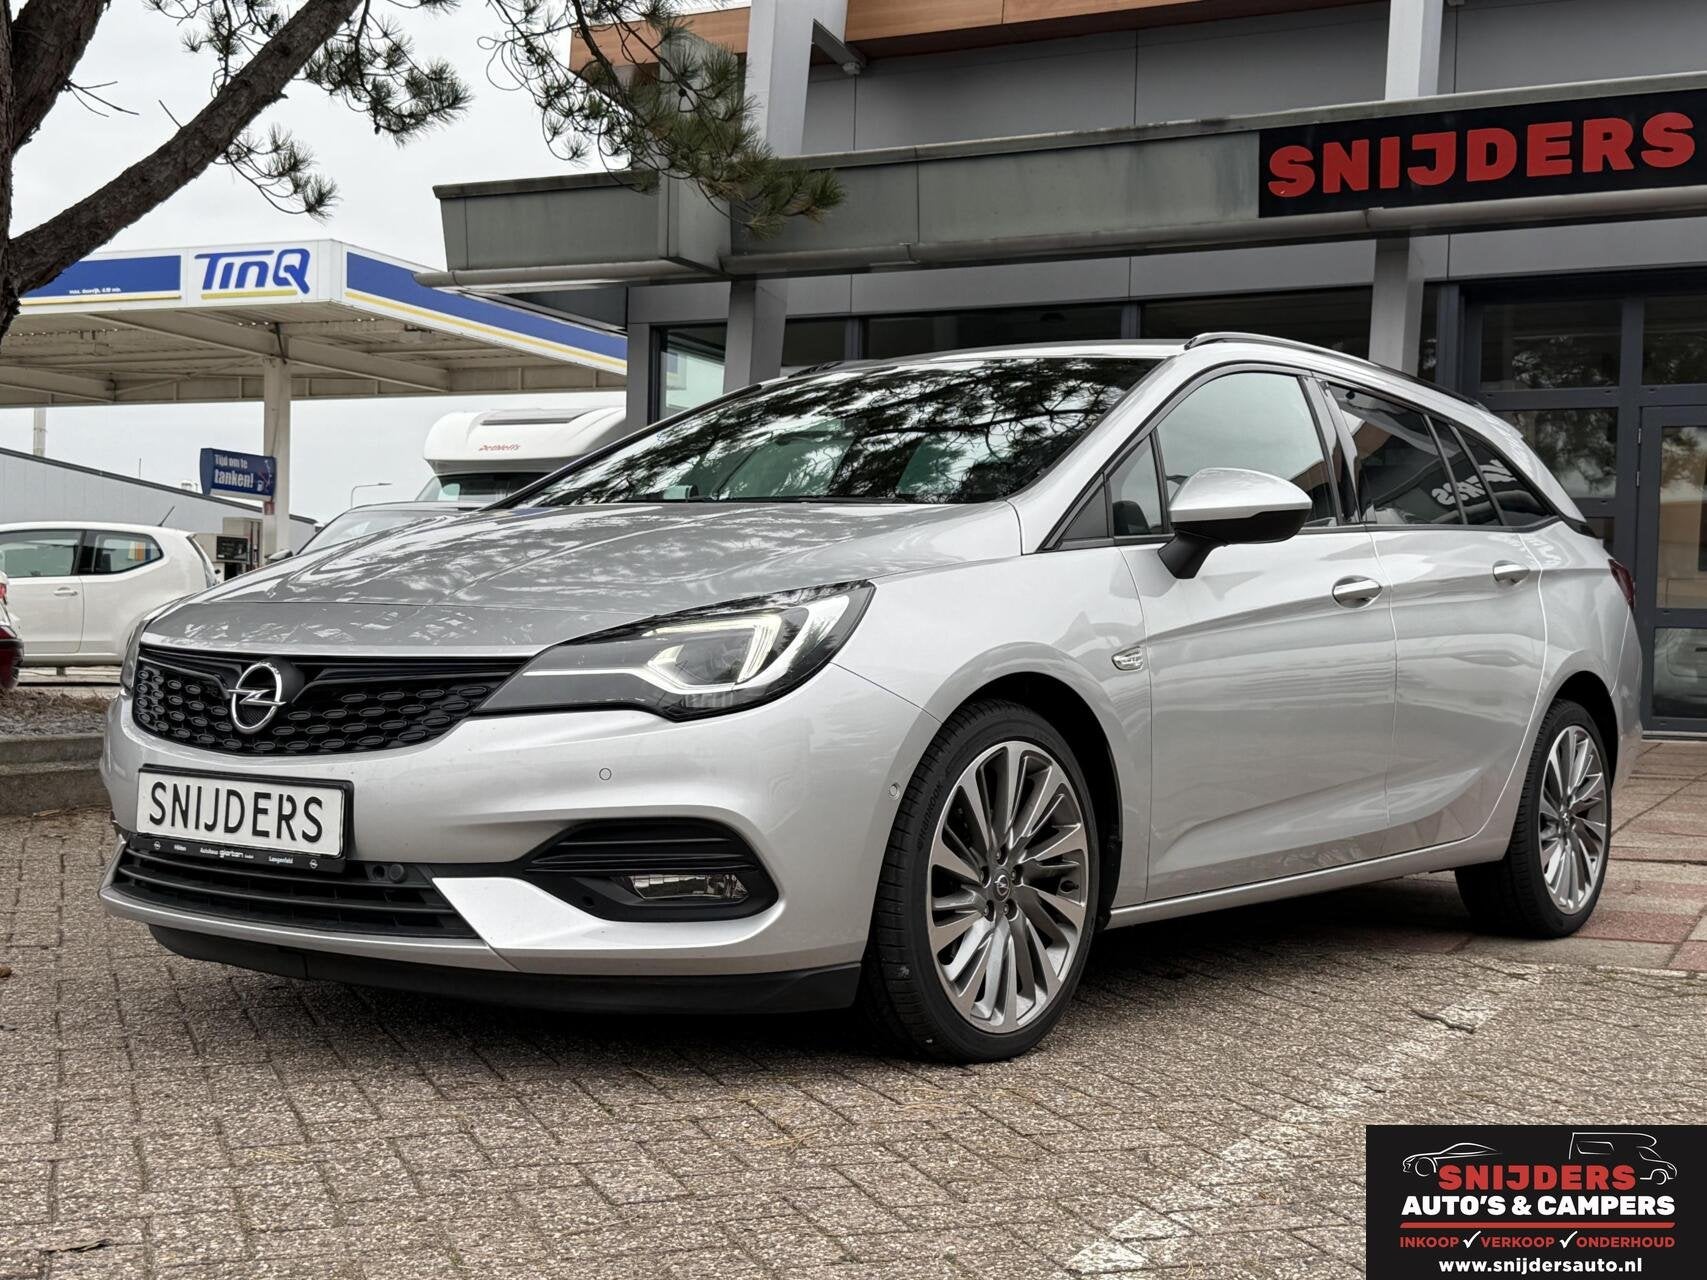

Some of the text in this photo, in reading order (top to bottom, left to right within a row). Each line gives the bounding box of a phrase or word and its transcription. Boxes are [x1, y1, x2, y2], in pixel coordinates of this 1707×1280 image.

[1268, 112, 1696, 198] SNIJDERS
[214, 469, 254, 488] tanken!
[149, 781, 323, 843] SNIJDERS
